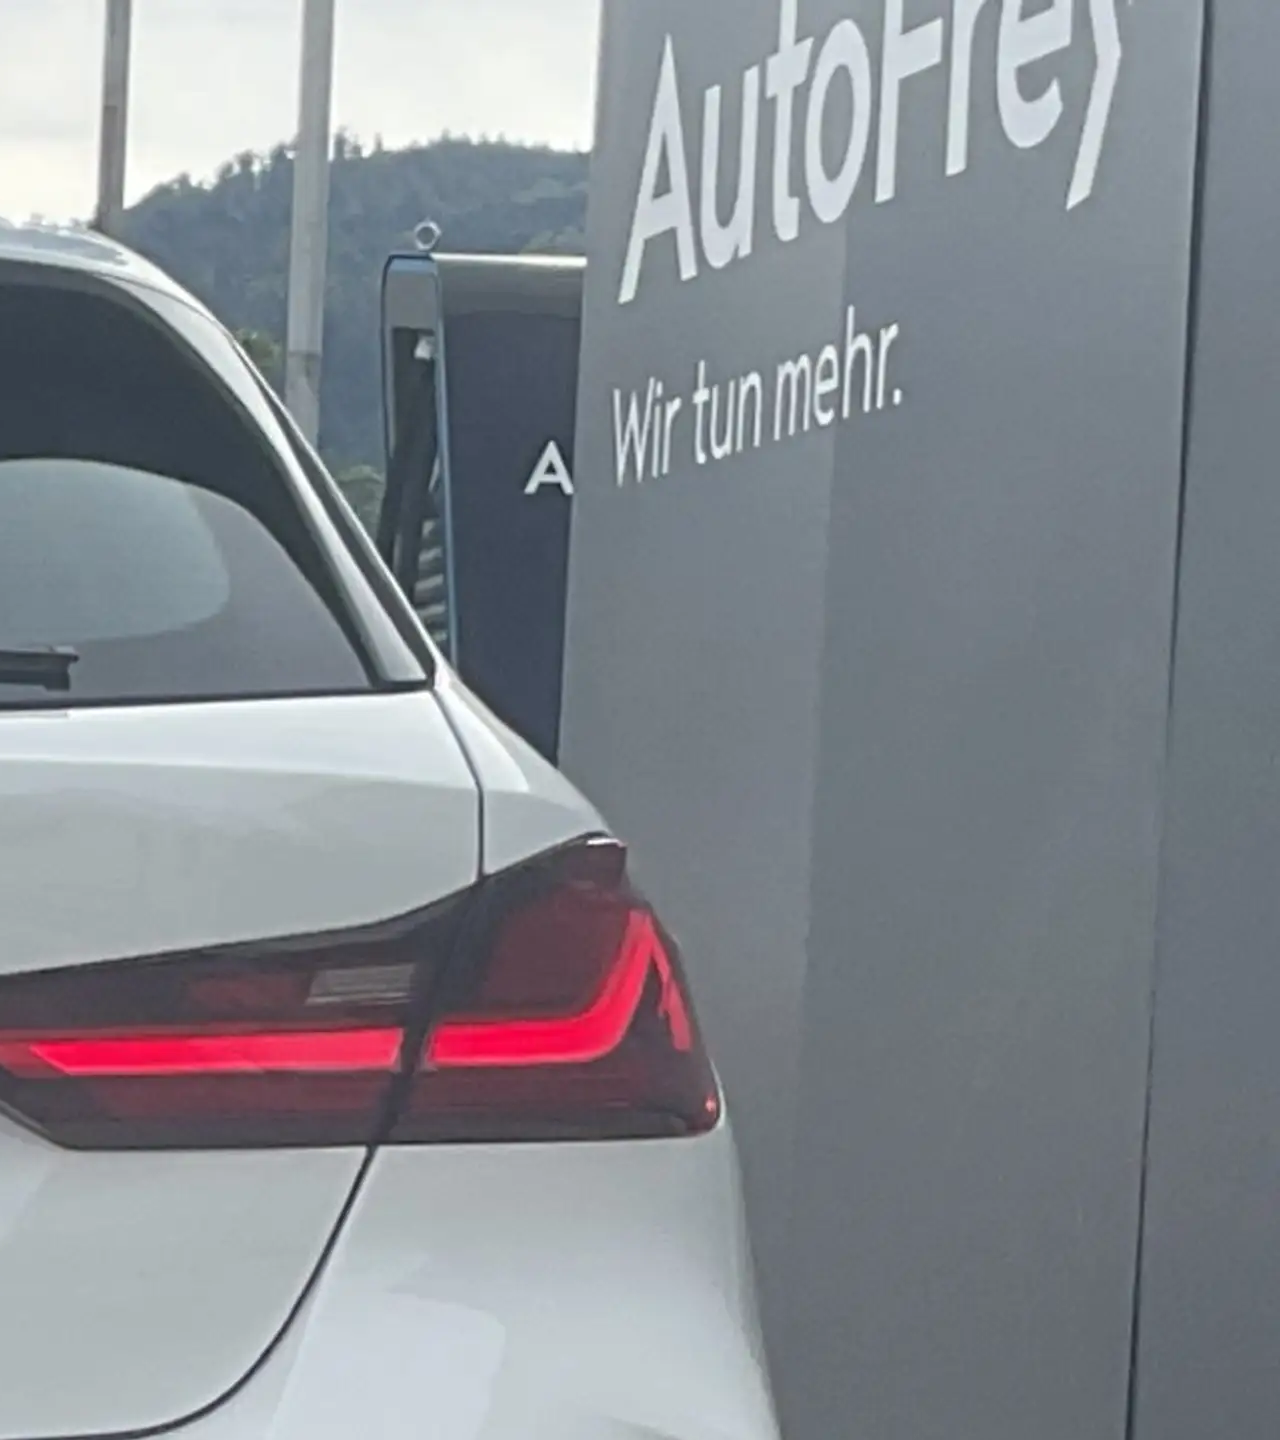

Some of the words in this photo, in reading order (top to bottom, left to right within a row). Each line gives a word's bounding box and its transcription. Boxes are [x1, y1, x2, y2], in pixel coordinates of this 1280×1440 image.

[618, 0, 1130, 303] AutoFrey
[614, 376, 682, 487] Wir
[693, 360, 762, 464] tun
[774, 305, 902, 441] mehr.
